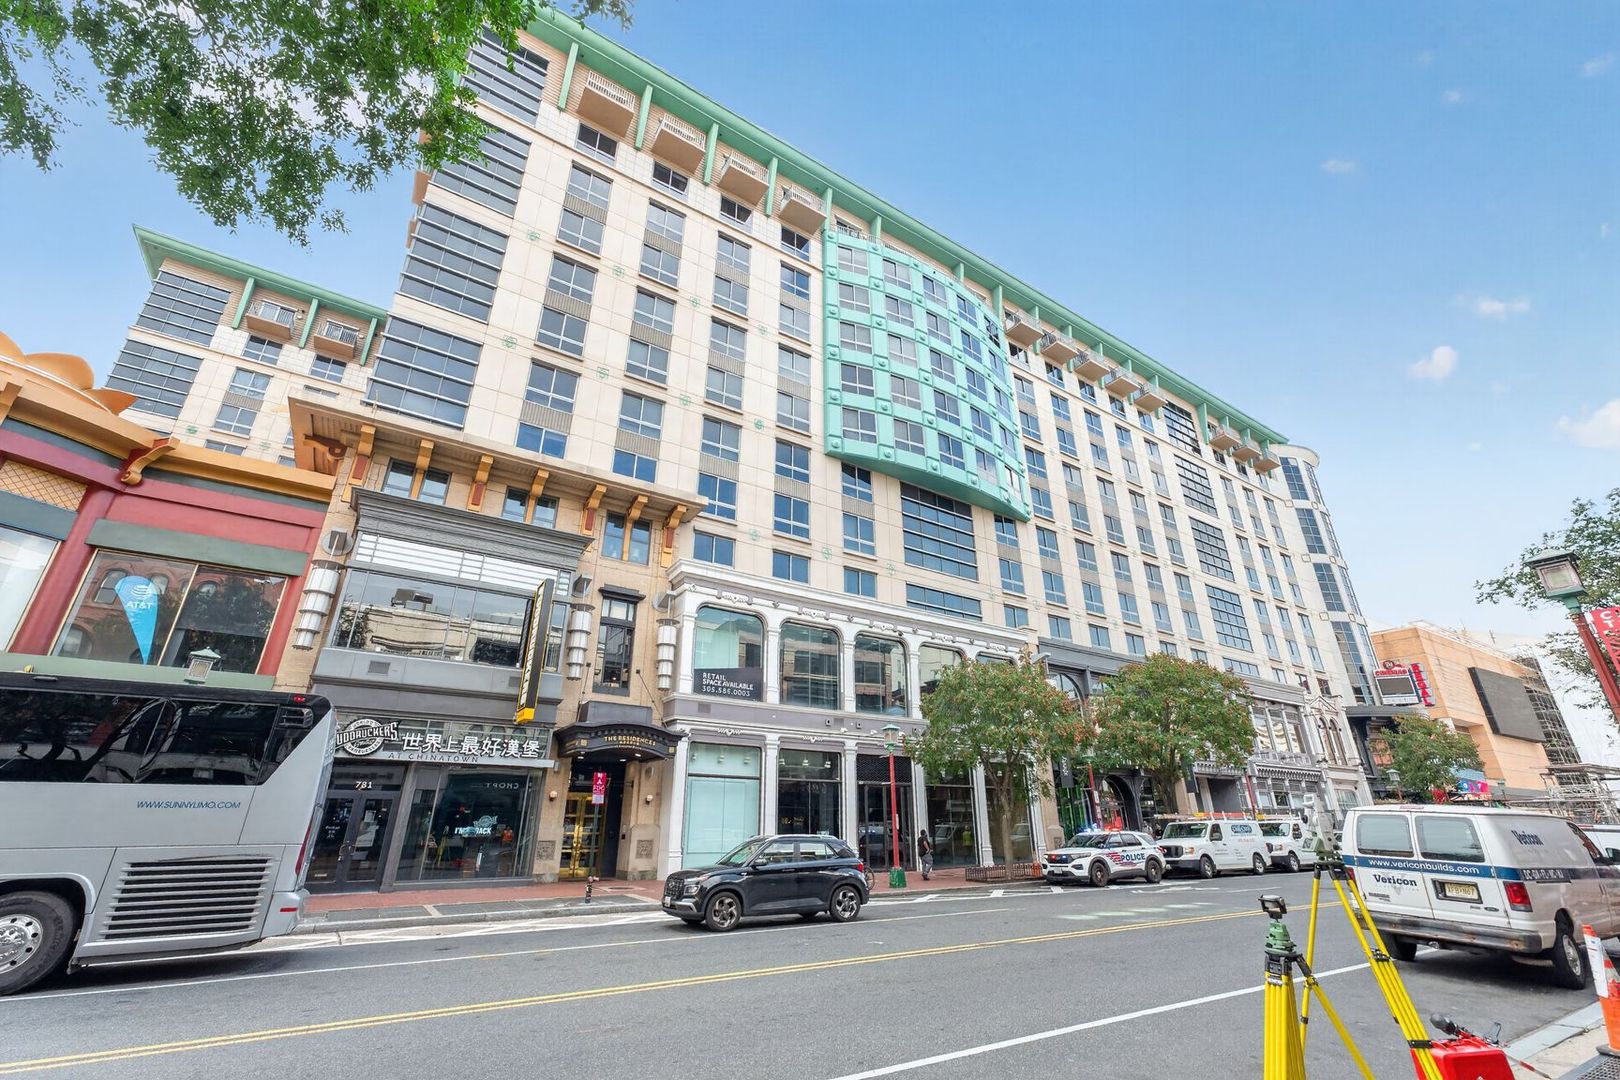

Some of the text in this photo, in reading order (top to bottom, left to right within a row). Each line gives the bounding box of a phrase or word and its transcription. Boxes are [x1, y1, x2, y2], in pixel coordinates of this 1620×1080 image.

[127, 601, 153, 609] AT&T
[702, 672, 726, 681] RETAIL
[702, 679, 754, 690] SPACE AVAILABLE
[1411, 663, 1433, 705] REGAL
[336, 722, 399, 746] UDDRUCKERS
[402, 732, 540, 758] 世界上最好漢堡
[618, 735, 656, 746] RESIDENCES
[408, 753, 479, 763] CHINATOWN
[355, 781, 373, 789] 781
[137, 800, 241, 809] WWW.SUNNYLIMO.COM
[1120, 853, 1146, 861] POLICE
[1368, 859, 1480, 875] www.vericonbuilds.com
[1373, 874, 1418, 887] Vericon
